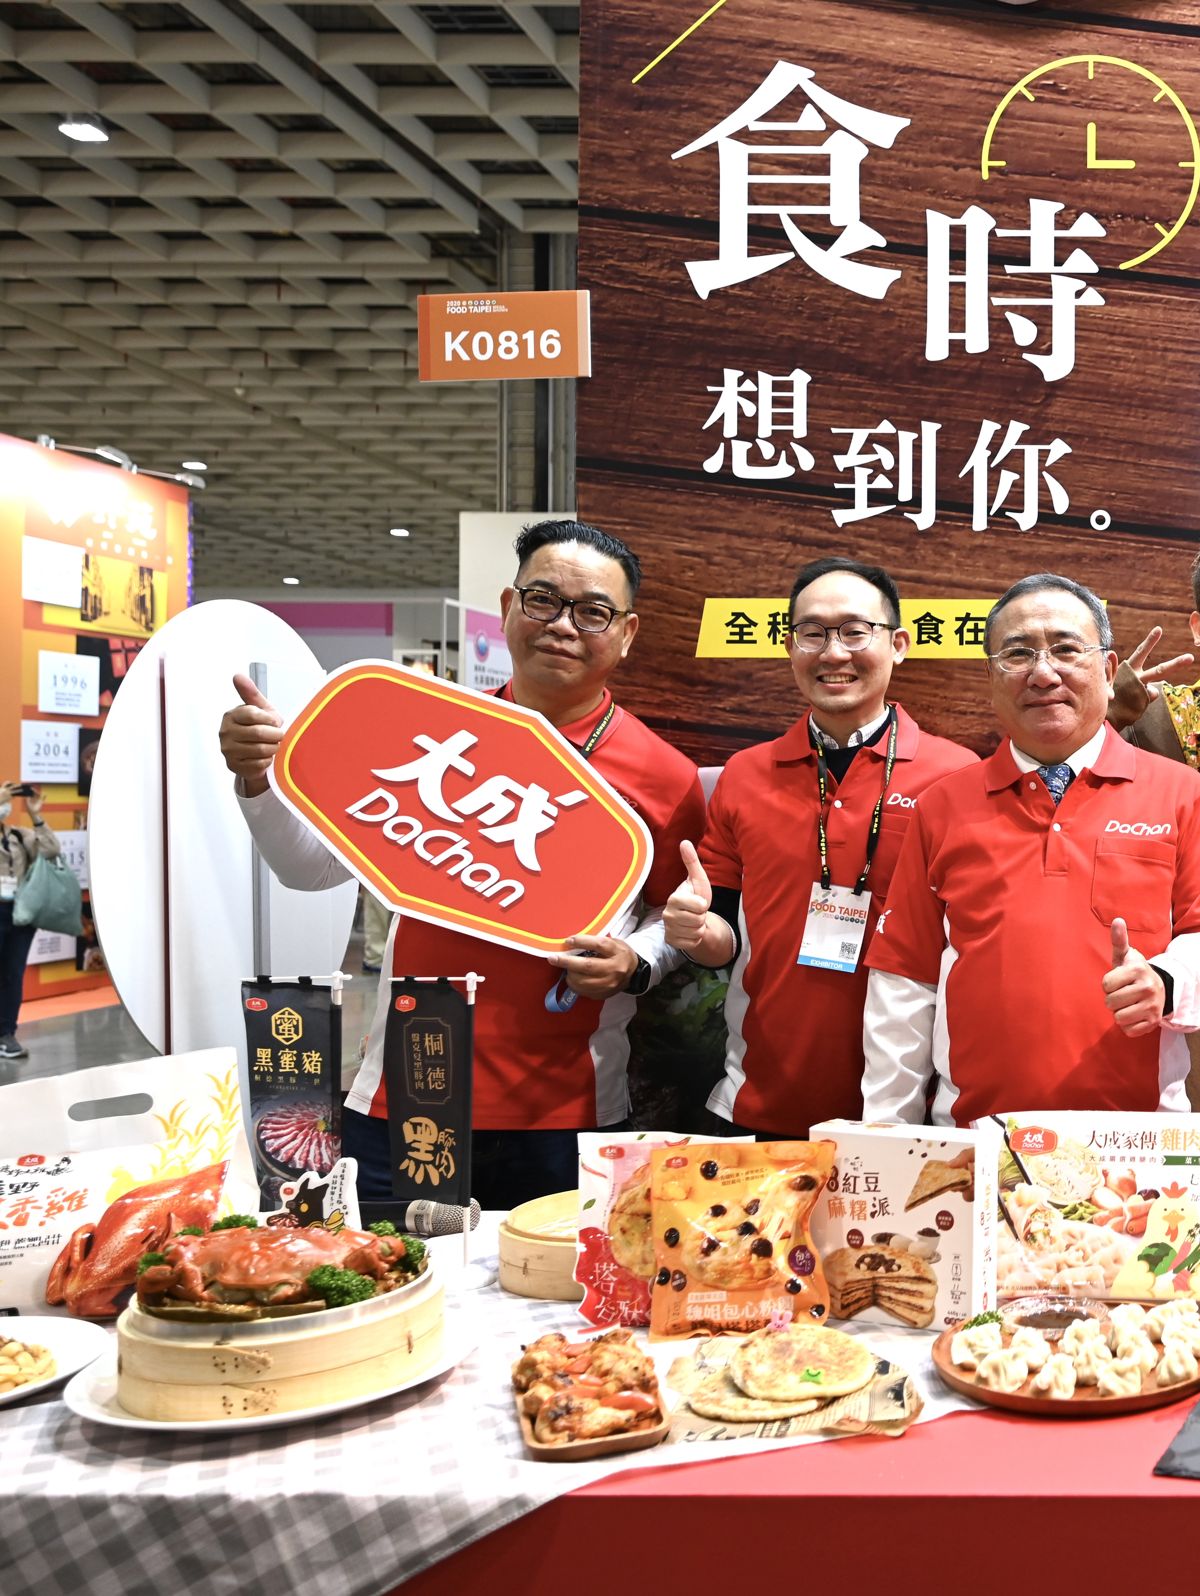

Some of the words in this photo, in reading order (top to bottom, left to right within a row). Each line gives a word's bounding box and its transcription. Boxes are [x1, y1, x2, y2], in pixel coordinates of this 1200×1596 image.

[670, 59, 1106, 383] 食時
[446, 306, 467, 314] FOOD
[444, 329, 562, 362] K0816
[702, 367, 1112, 533] 想到你。
[52, 674, 88, 690] 1996
[34, 743, 70, 757] 2004
[370, 729, 590, 872] 大成
[1105, 819, 1171, 836] DaChan
[345, 787, 526, 909] DaChan
[811, 902, 836, 913] FOOD
[838, 906, 867, 919] TAIPEI
[276, 1011, 298, 1039] 蜜
[253, 1047, 323, 1075] 黑蜜豬
[424, 1033, 446, 1091] 桐德
[1022, 1132, 1043, 1144] 大成
[841, 1171, 882, 1195] 紅豆
[0, 1187, 88, 1230] 香雞
[829, 1196, 891, 1222] 麻糬派
